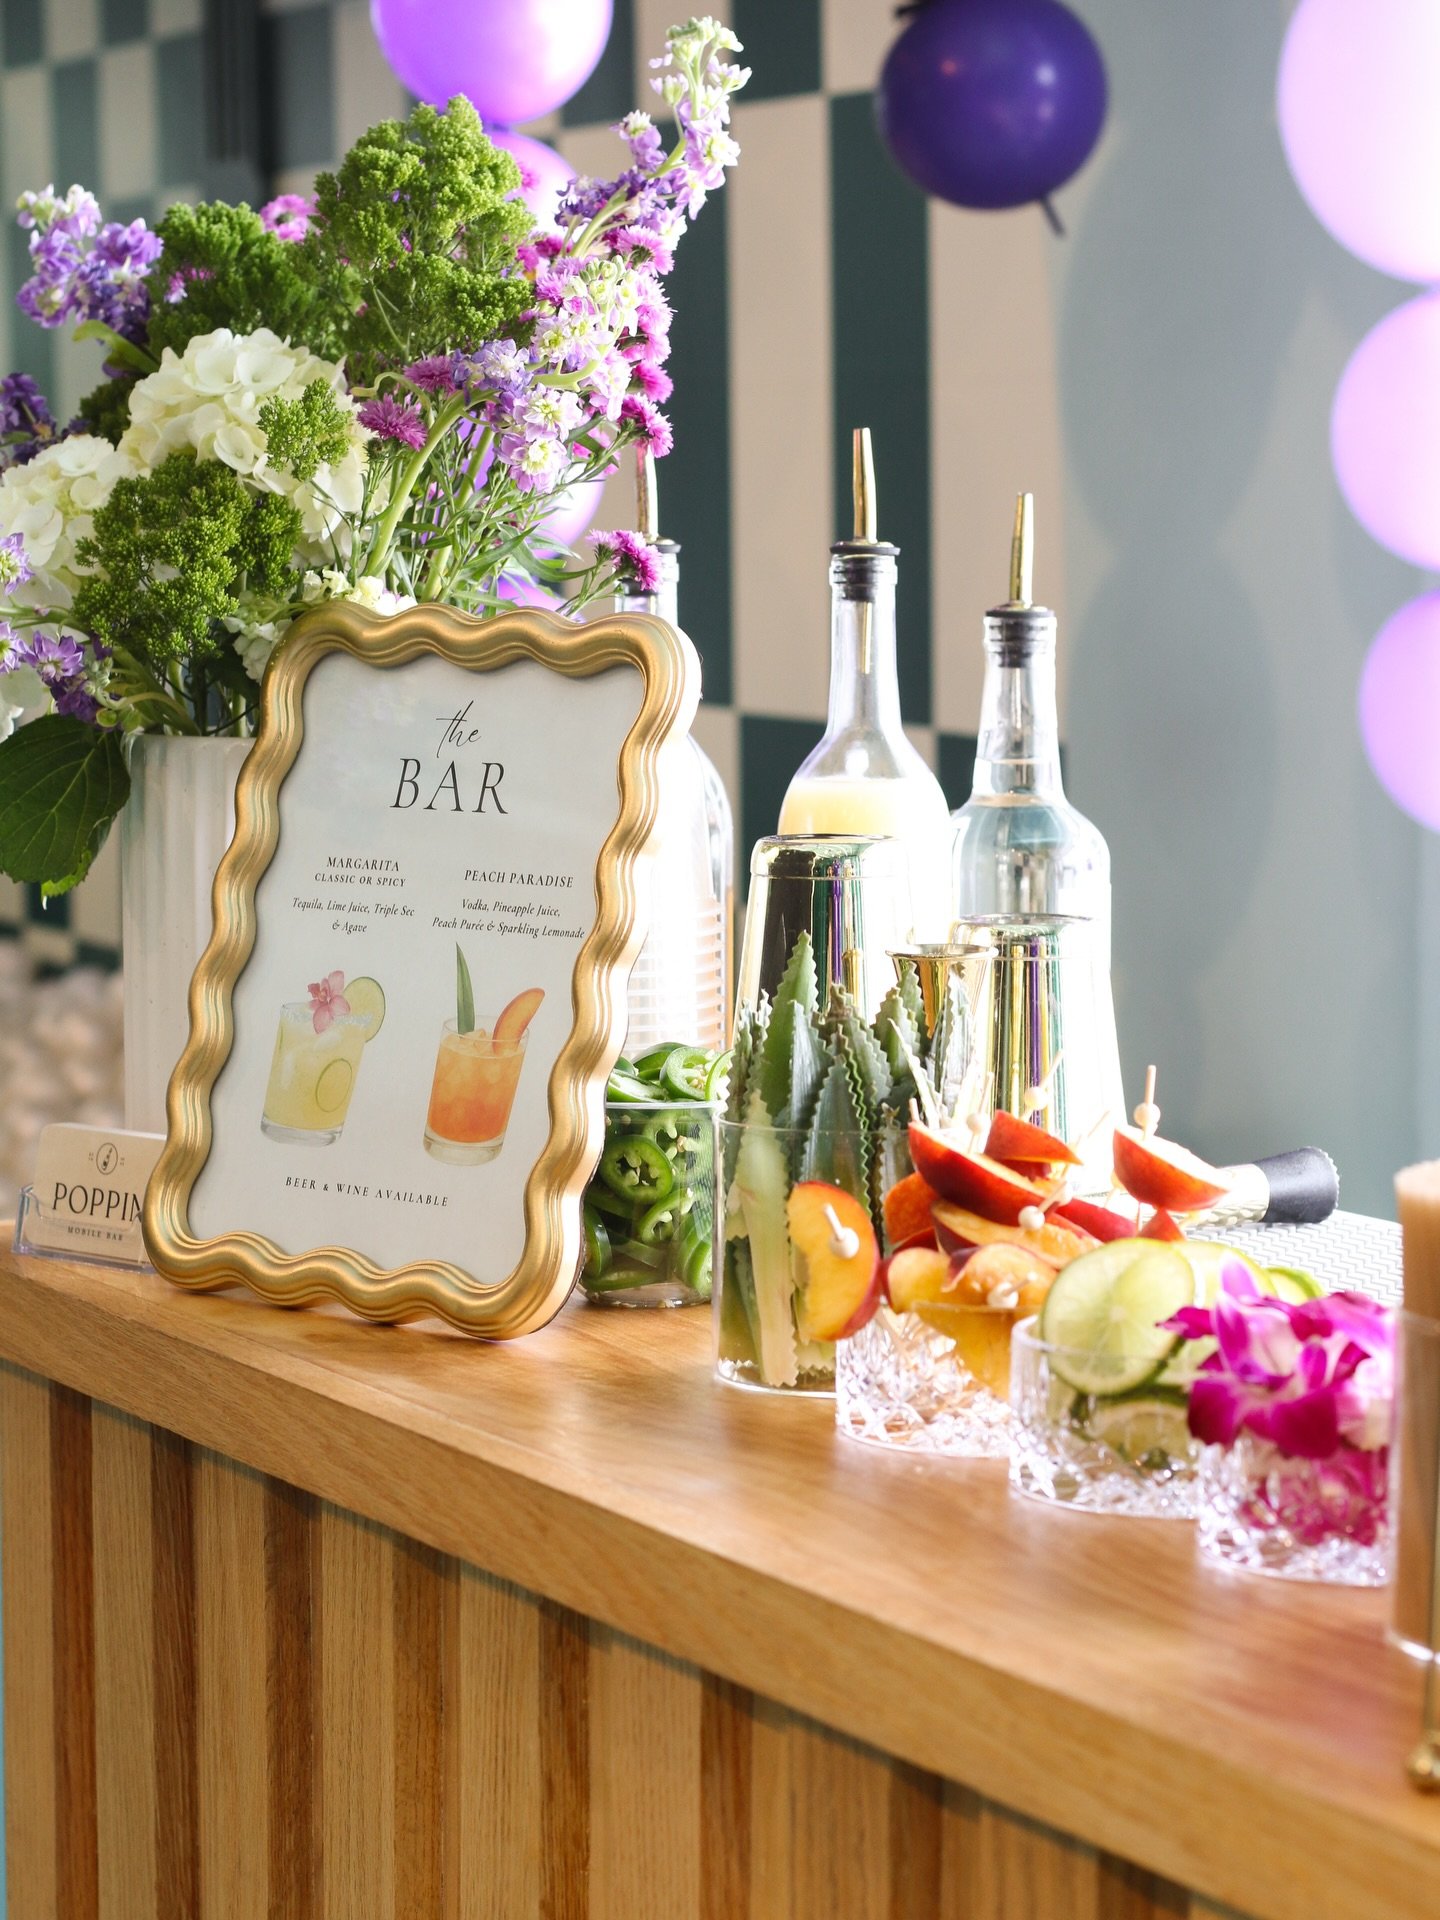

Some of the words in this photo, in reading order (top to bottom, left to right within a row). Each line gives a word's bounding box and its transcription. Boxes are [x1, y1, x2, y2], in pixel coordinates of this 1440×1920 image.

[436, 700, 481, 758] the
[390, 758, 508, 814] BAR
[327, 856, 400, 872] MARGARITA
[314, 873, 356, 884] CLASSIC
[359, 876, 372, 885] OR
[376, 877, 406, 887] SPICY
[464, 869, 506, 883] PEACH
[509, 872, 574, 888] PARADISE
[292, 897, 324, 912] Tequila,
[326, 900, 347, 912] Lime
[347, 901, 370, 914] Juice,
[374, 903, 399, 918] Triple
[400, 905, 415, 917] Sec
[461, 898, 489, 912] Vodka,
[493, 901, 535, 917] Pineapple
[536, 904, 561, 917] Juice,
[332, 919, 340, 930] &
[342, 921, 368, 935] Agave
[432, 916, 457, 929] Peach
[459, 919, 484, 931] Purée
[486, 920, 495, 931] &
[497, 921, 540, 939] Sparkling
[541, 925, 585, 939] Lemonade
[285, 1176, 316, 1190] BEER
[322, 1183, 329, 1192] &
[336, 1183, 369, 1197] WINE
[375, 1189, 448, 1207] AVAILABLE
[67, 1225, 102, 1238] MOBILE
[106, 1231, 123, 1241] BAR
